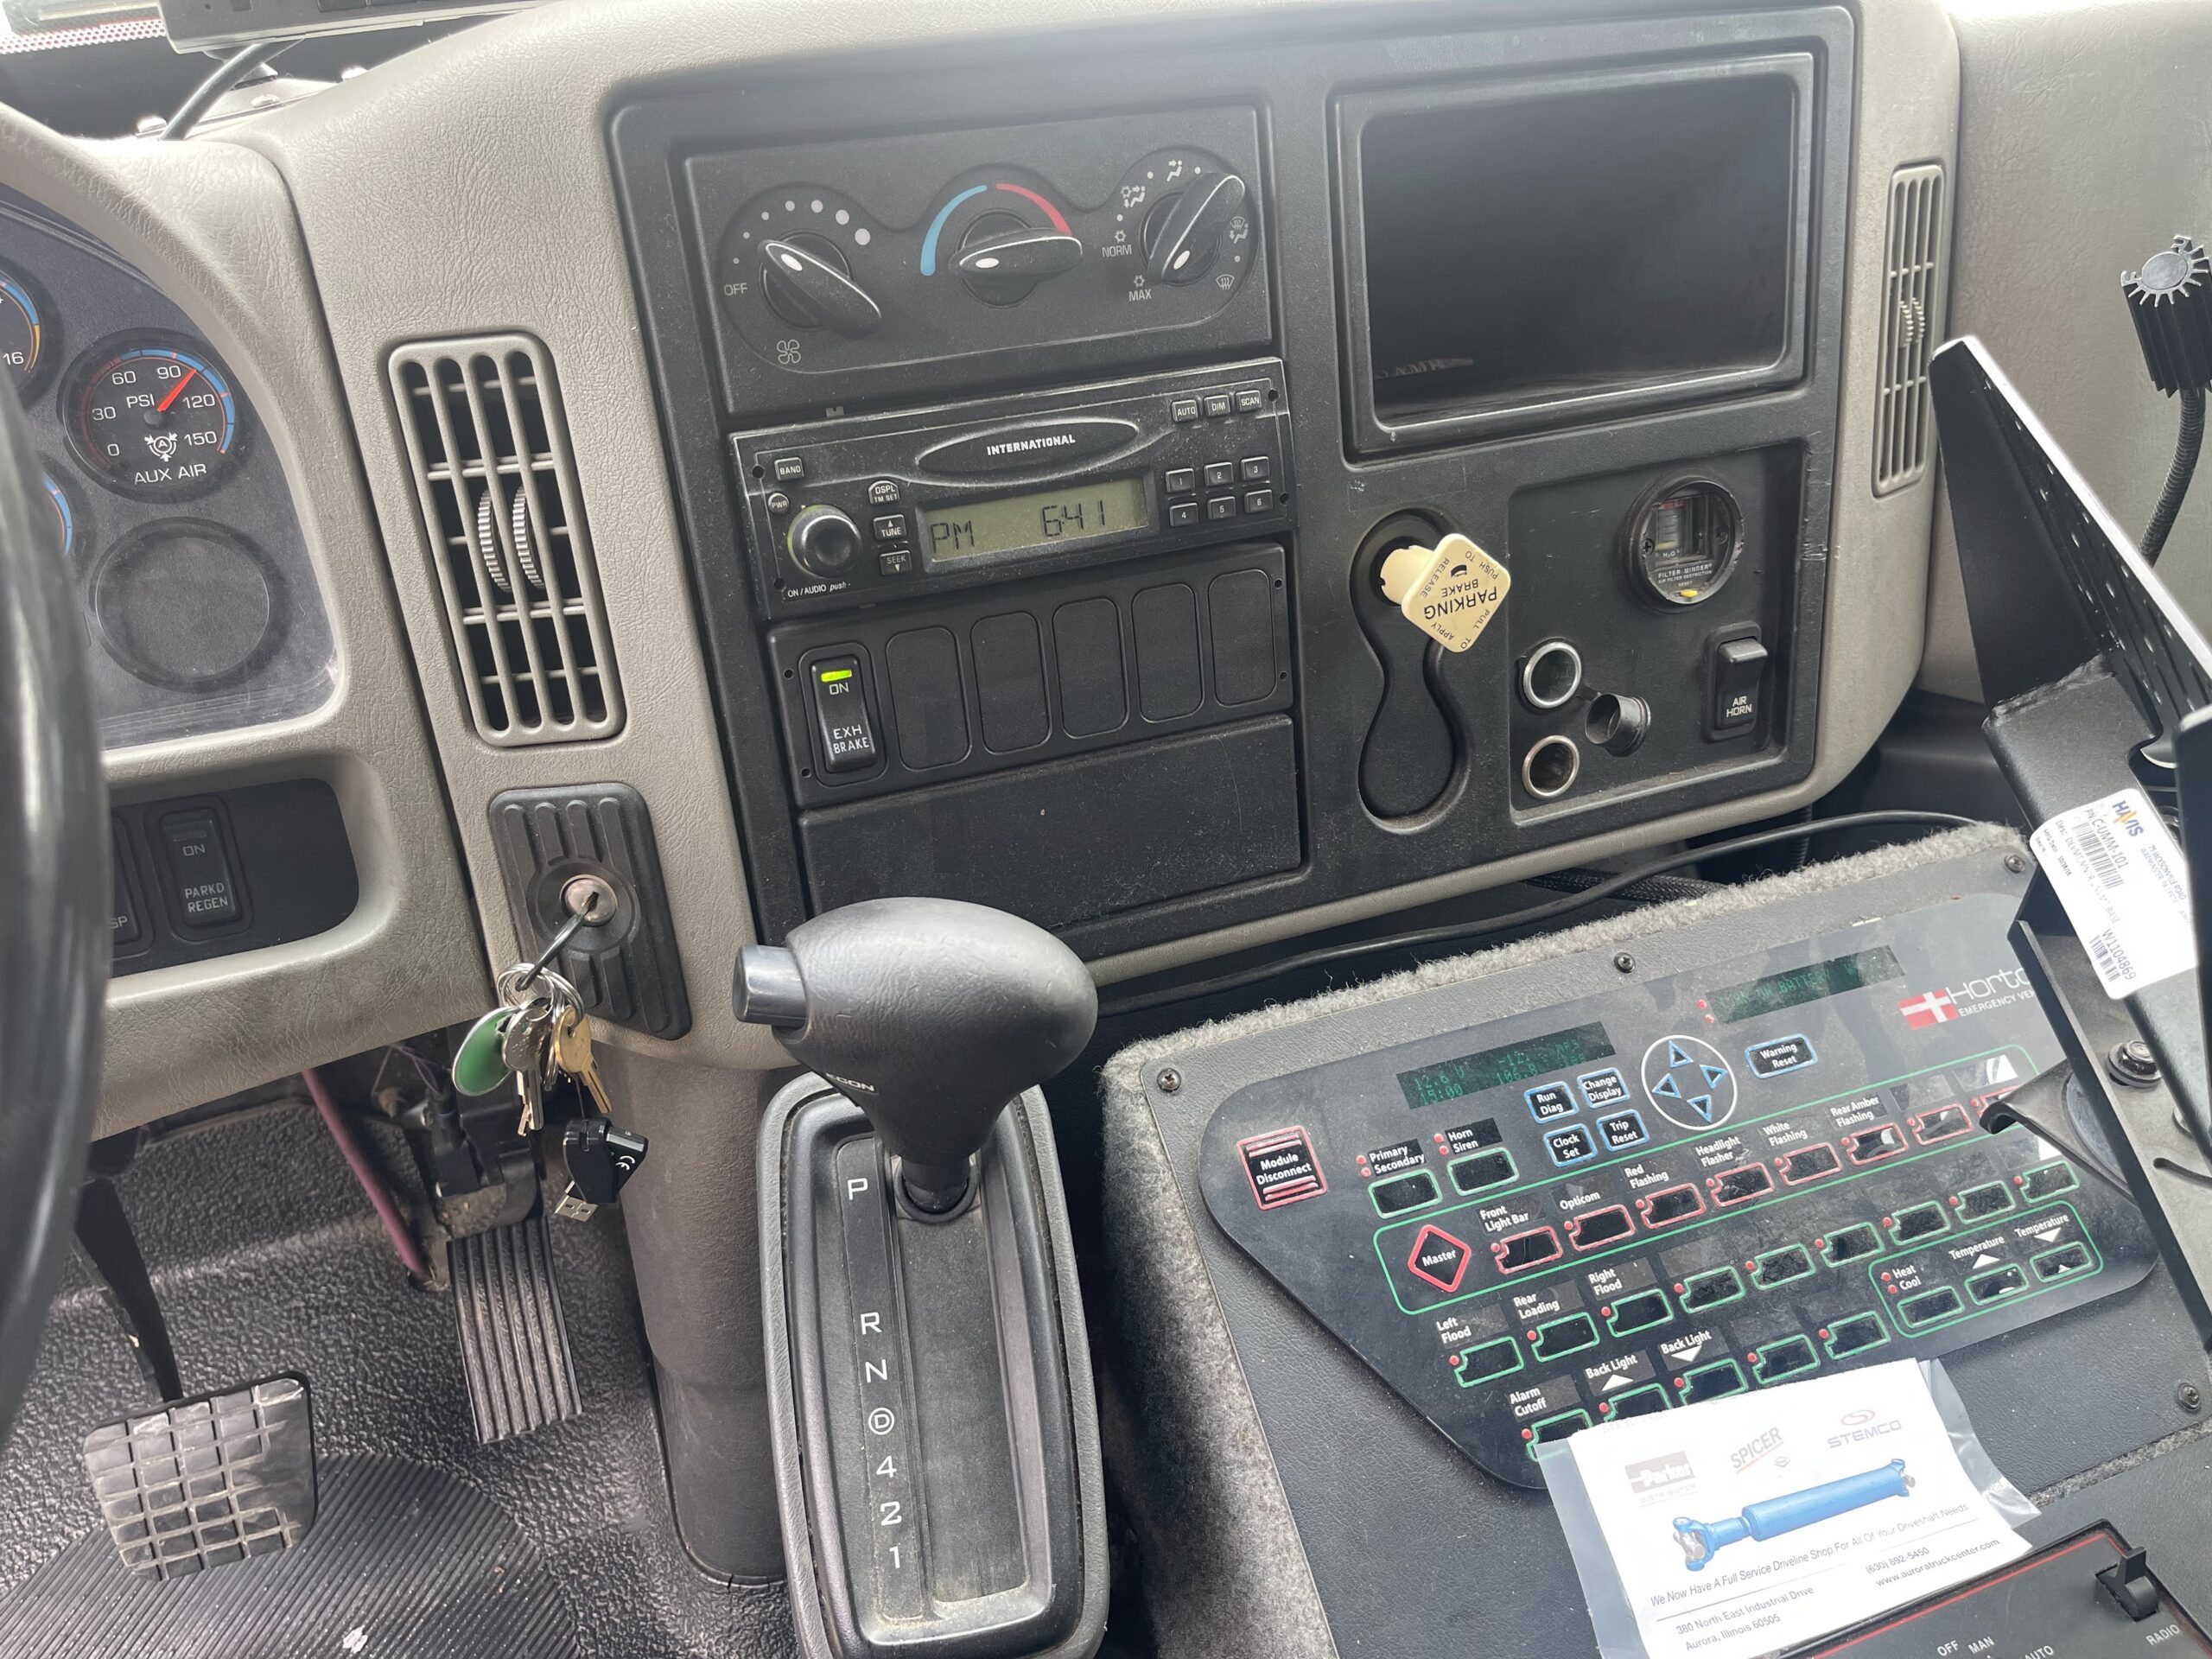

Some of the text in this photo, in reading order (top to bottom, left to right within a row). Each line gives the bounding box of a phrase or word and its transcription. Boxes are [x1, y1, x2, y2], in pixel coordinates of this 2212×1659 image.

[1102, 244, 1132, 257] NORM
[724, 282, 747, 296] OFF
[1128, 289, 1152, 302] MAX
[3, 352, 24, 365] 16
[111, 371, 136, 385] 60
[156, 365, 181, 379] 90
[126, 394, 156, 409] PSI
[183, 394, 215, 409] 120
[1211, 402, 1226, 411] DIM
[1241, 397, 1260, 406] SCAN
[92, 406, 117, 422] 30
[1177, 407, 1196, 416] AUTO
[184, 431, 217, 446] 150
[987, 434, 1076, 455] INTERNATIONAL
[107, 444, 120, 457] 0
[134, 463, 207, 485] AUX AIR
[779, 465, 801, 475] BAND
[874, 486, 896, 495] DSPL
[771, 500, 788, 509] PWR
[880, 527, 901, 537] TUNE
[931, 499, 1105, 553] PM 6:41
[887, 556, 906, 564] SEEK
[1421, 550, 1499, 597] PUSH TO RELEASE
[1658, 569, 1681, 579] FILTER
[830, 581, 847, 593] push
[1441, 578, 1478, 598] BRAKE
[1424, 587, 1497, 620] PARKING
[1431, 609, 1490, 649] PULL TO APPLY
[829, 682, 849, 696] ON
[1732, 696, 1747, 707] AIR
[1726, 703, 1752, 718] HORN
[833, 724, 862, 740] EXH
[833, 737, 869, 754] BRAKE
[182, 843, 206, 856] ON
[184, 882, 225, 899] PARKD
[188, 896, 228, 912] REGEN
[1945, 967, 2031, 1005] Horto
[1958, 995, 2016, 1017] EMERGENCY
[1759, 1043, 1798, 1059] Warning
[1772, 1055, 1797, 1069] Reset
[1582, 1076, 1617, 1090] Change
[1536, 1092, 1556, 1103] Run
[1588, 1087, 1622, 1102] Display
[1540, 1103, 1564, 1116] Diag
[1830, 1096, 1879, 1117] Rear Amber
[1610, 1121, 1630, 1132] Trip
[1836, 1109, 1875, 1128] Flashing
[1447, 1128, 1473, 1141] Horn
[1763, 1122, 1790, 1136] White
[1554, 1135, 1580, 1148] Clock
[1611, 1130, 1638, 1145] Reset
[1768, 1128, 1808, 1147] Flashing
[1452, 1139, 1478, 1154] Siren
[1562, 1147, 1580, 1159] Set
[1694, 1135, 1741, 1157] Headlight
[1260, 1153, 1299, 1171] Module
[1369, 1145, 1408, 1164] Primary
[1700, 1151, 1733, 1167] Flasher
[1374, 1153, 1425, 1174] Secondary
[1624, 1164, 1645, 1178] Red
[1255, 1162, 1312, 1185] Disconnect
[1629, 1171, 1669, 1189] Flashing
[847, 1179, 868, 1200] P
[1560, 1191, 1601, 1211] Opticom
[1479, 1205, 1507, 1220] Front
[1484, 1211, 1529, 1233] Light Bar
[2014, 1214, 2069, 1237] Temperature
[1948, 1235, 2005, 1261] Temperature
[1422, 1249, 1457, 1267] Master
[1588, 1268, 1617, 1285] Right
[1891, 1264, 1916, 1281] Heat
[1593, 1279, 1623, 1296] Flood
[1899, 1276, 1922, 1291] Cool
[1513, 1294, 1537, 1307] Rear
[1517, 1300, 1560, 1319] Loading
[860, 1312, 883, 1335] R
[1436, 1318, 1458, 1332] Left
[1440, 1327, 1471, 1344] Flood
[1660, 1330, 1712, 1354] Back Light
[865, 1360, 887, 1383] N
[1586, 1354, 1638, 1379] Back Light
[1510, 1388, 1541, 1404] Alarm
[1514, 1399, 1547, 1417] Cutoff
[1827, 1420, 1902, 1449] STEMCO
[1730, 1427, 1783, 1469] SPICER
[876, 1456, 897, 1478] 4
[880, 1502, 902, 1525] 2
[890, 1547, 901, 1568] 1
[1650, 1596, 1665, 1607] We
[1667, 1590, 1688, 1603] Now
[1689, 1583, 1712, 1596] Have
[1713, 1578, 1721, 1588] A
[1722, 1573, 1738, 1586] Full
[1739, 1566, 1771, 1581] Service
[1773, 1555, 1809, 1571] Driveline
[1810, 1546, 1834, 1560] Shop
[1834, 1541, 1849, 1551] For
[1852, 1535, 1863, 1547] All
[1941, 1503, 1969, 1516] Needs
[1876, 1538, 2001, 1587] www.auroratruckcenter.com
[1676, 1586, 1814, 1635] 380 North East Industrial Drive
[1686, 1613, 1781, 1651] Aurora, Illinois 60505
[2145, 1624, 2181, 1646] RADIO
[1937, 1640, 1960, 1657] OFF
[1967, 1636, 1995, 1655] MAN
[2024, 1645, 2055, 1659] AUTO
